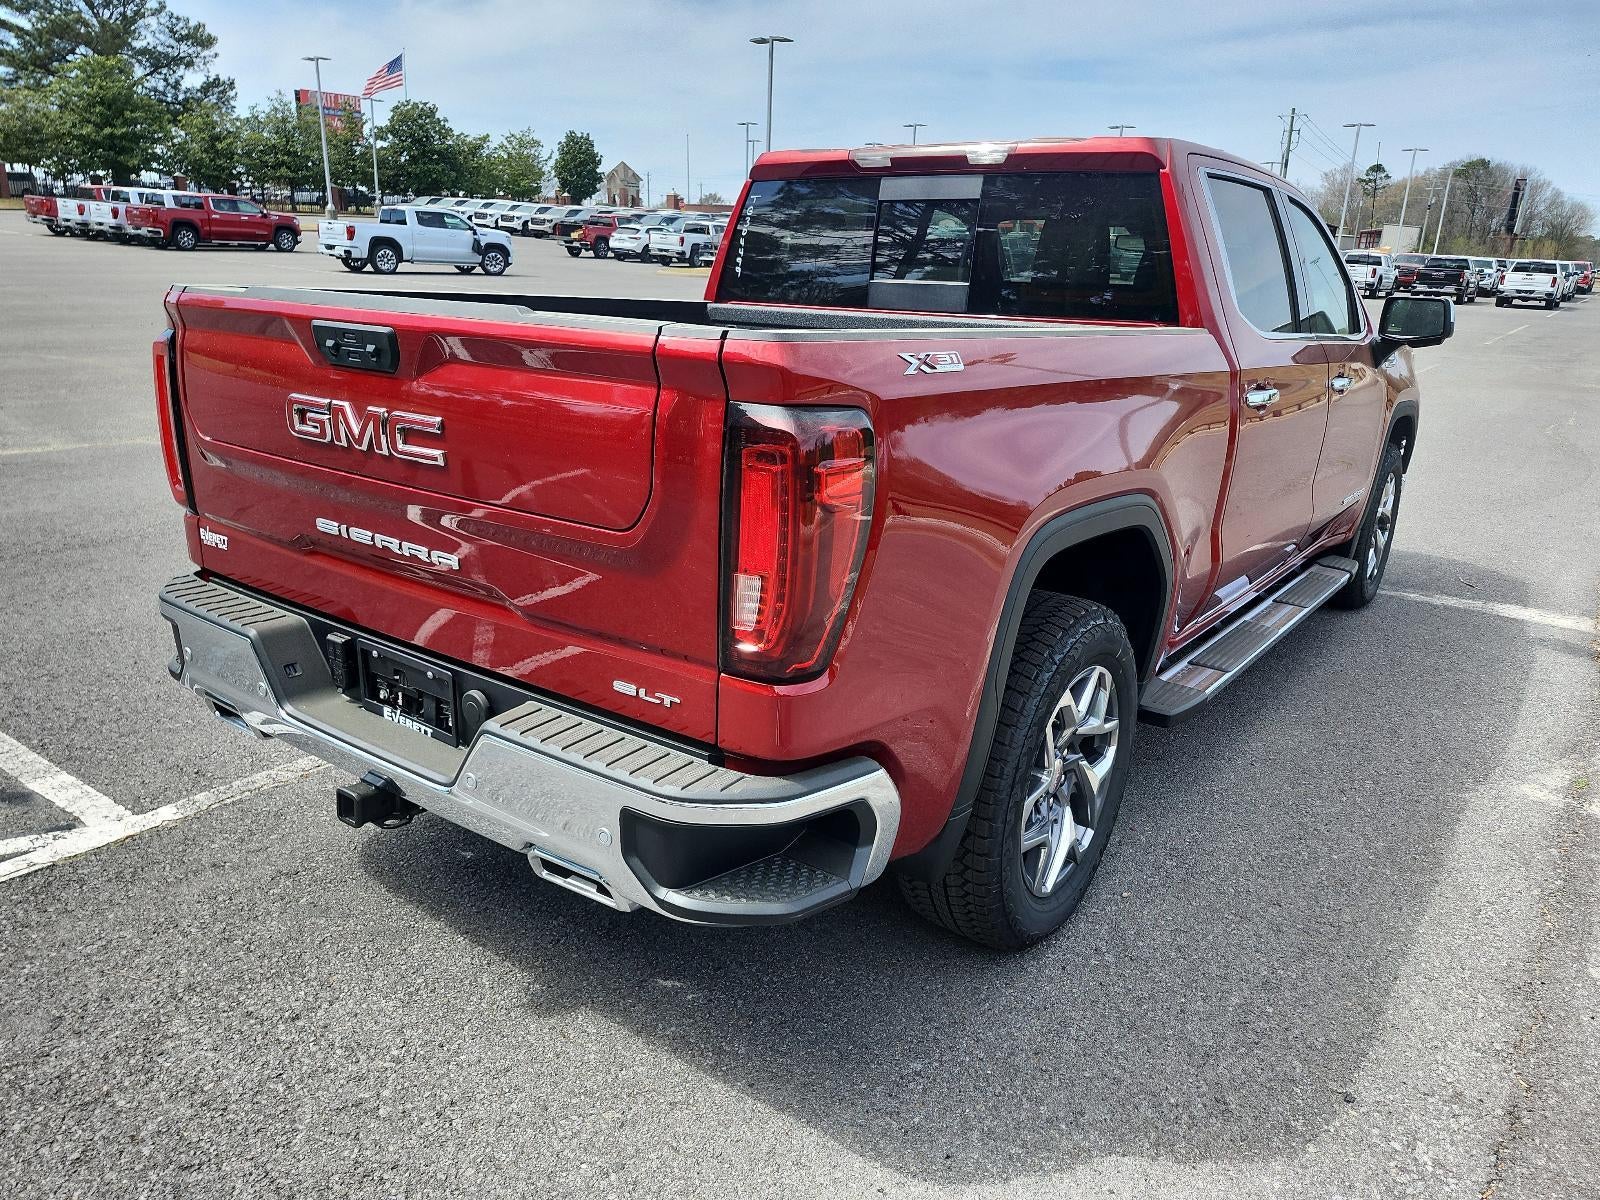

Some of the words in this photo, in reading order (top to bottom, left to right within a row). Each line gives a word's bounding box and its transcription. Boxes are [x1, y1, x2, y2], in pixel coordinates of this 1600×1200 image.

[286, 393, 447, 466] GMC
[200, 526, 228, 549] EVERETT
[316, 518, 459, 569] SIERRA
[613, 680, 681, 707] SLT
[383, 707, 433, 737] EVERETT
